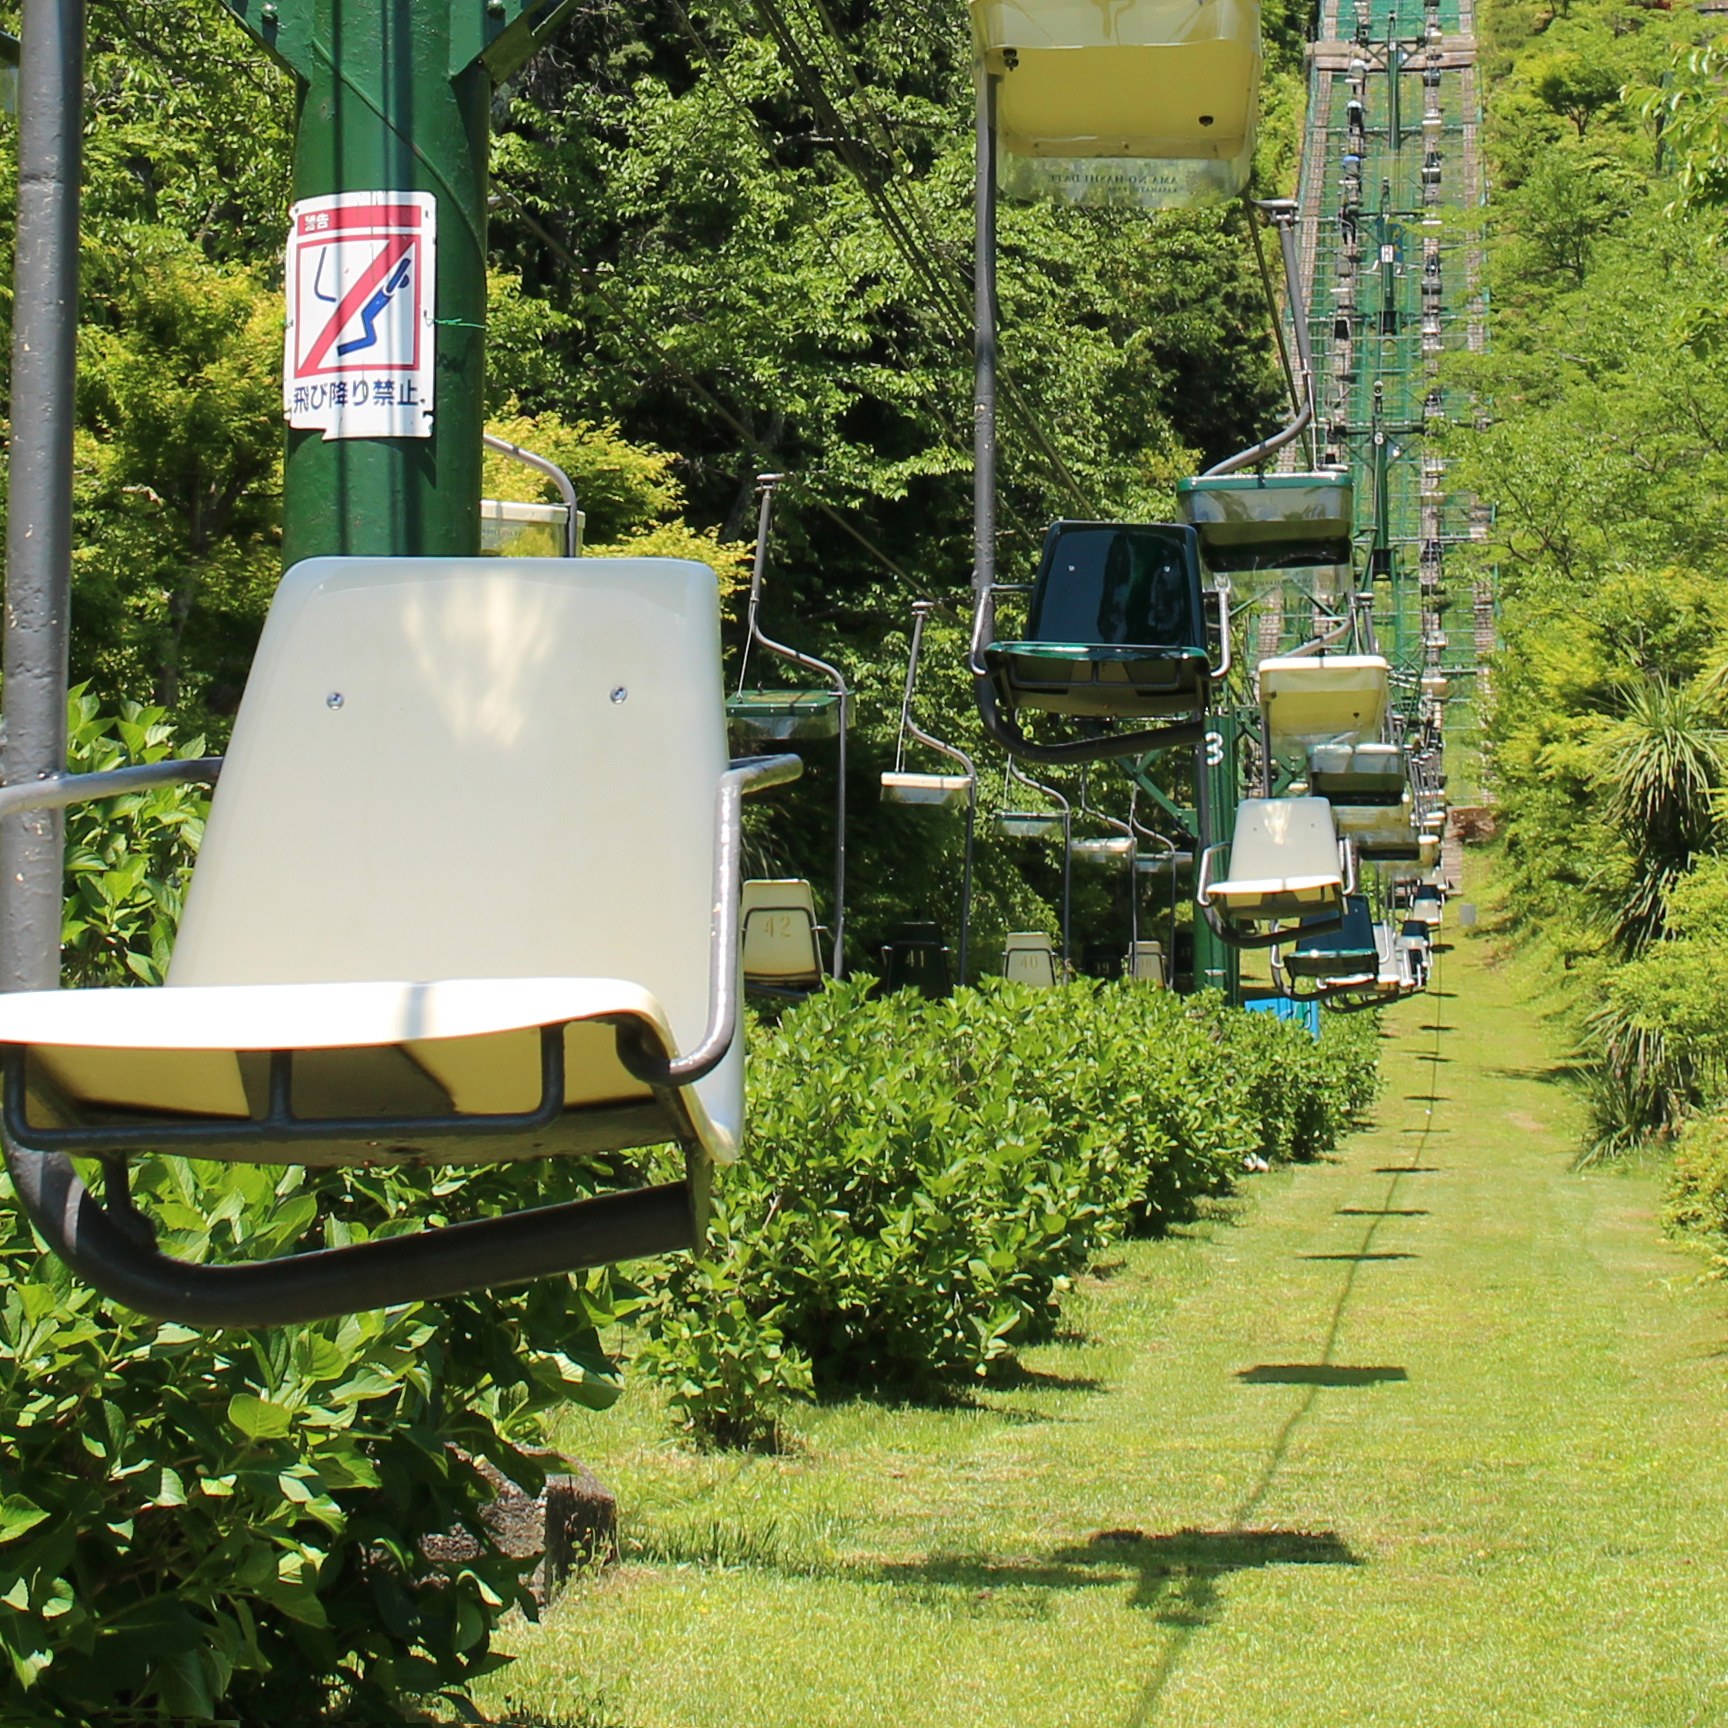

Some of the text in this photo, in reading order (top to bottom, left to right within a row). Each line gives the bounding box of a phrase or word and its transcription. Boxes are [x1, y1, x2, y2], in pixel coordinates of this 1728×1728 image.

[292, 379, 420, 414] 飛び降り禁止
[1374, 431, 1384, 445] 6
[1205, 731, 1224, 765] 3
[763, 915, 792, 938] 42
[905, 949, 925, 968] 41
[1019, 954, 1038, 970] 40
[1094, 961, 1110, 974] 39
